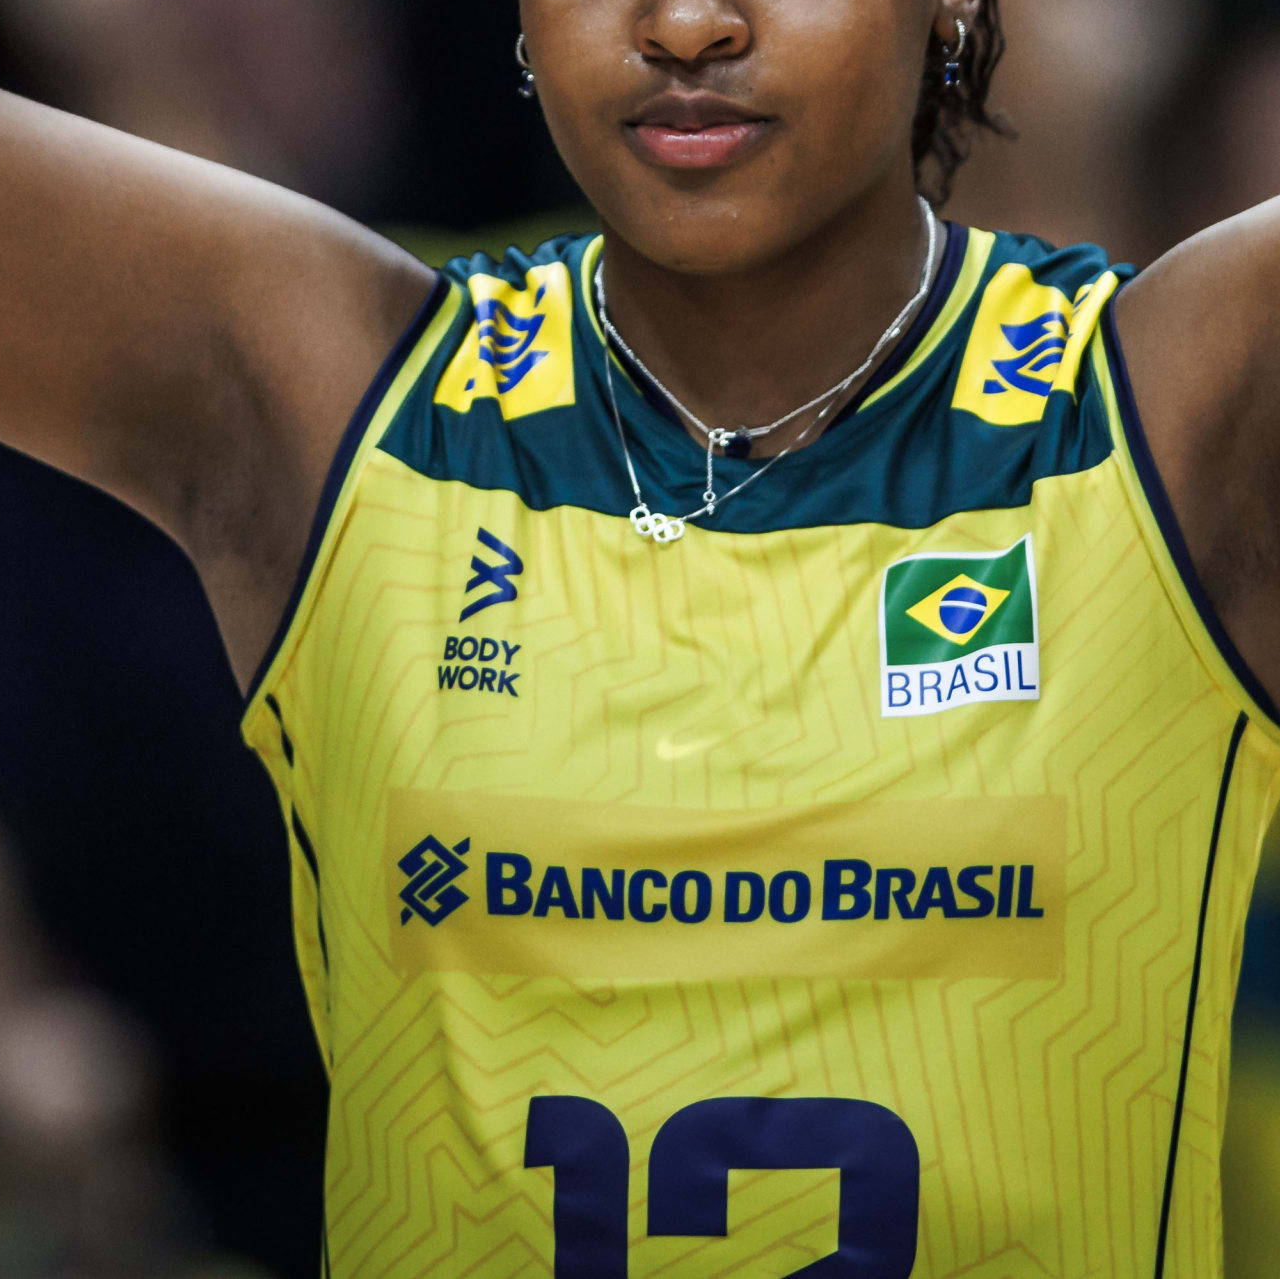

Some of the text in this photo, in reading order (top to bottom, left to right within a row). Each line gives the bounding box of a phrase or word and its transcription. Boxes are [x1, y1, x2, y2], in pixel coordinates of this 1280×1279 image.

[443, 635, 521, 666] BODY
[437, 665, 520, 698] WORK
[887, 649, 1037, 708] BRASIL
[485, 851, 1044, 924] BANCO DO BRASIL
